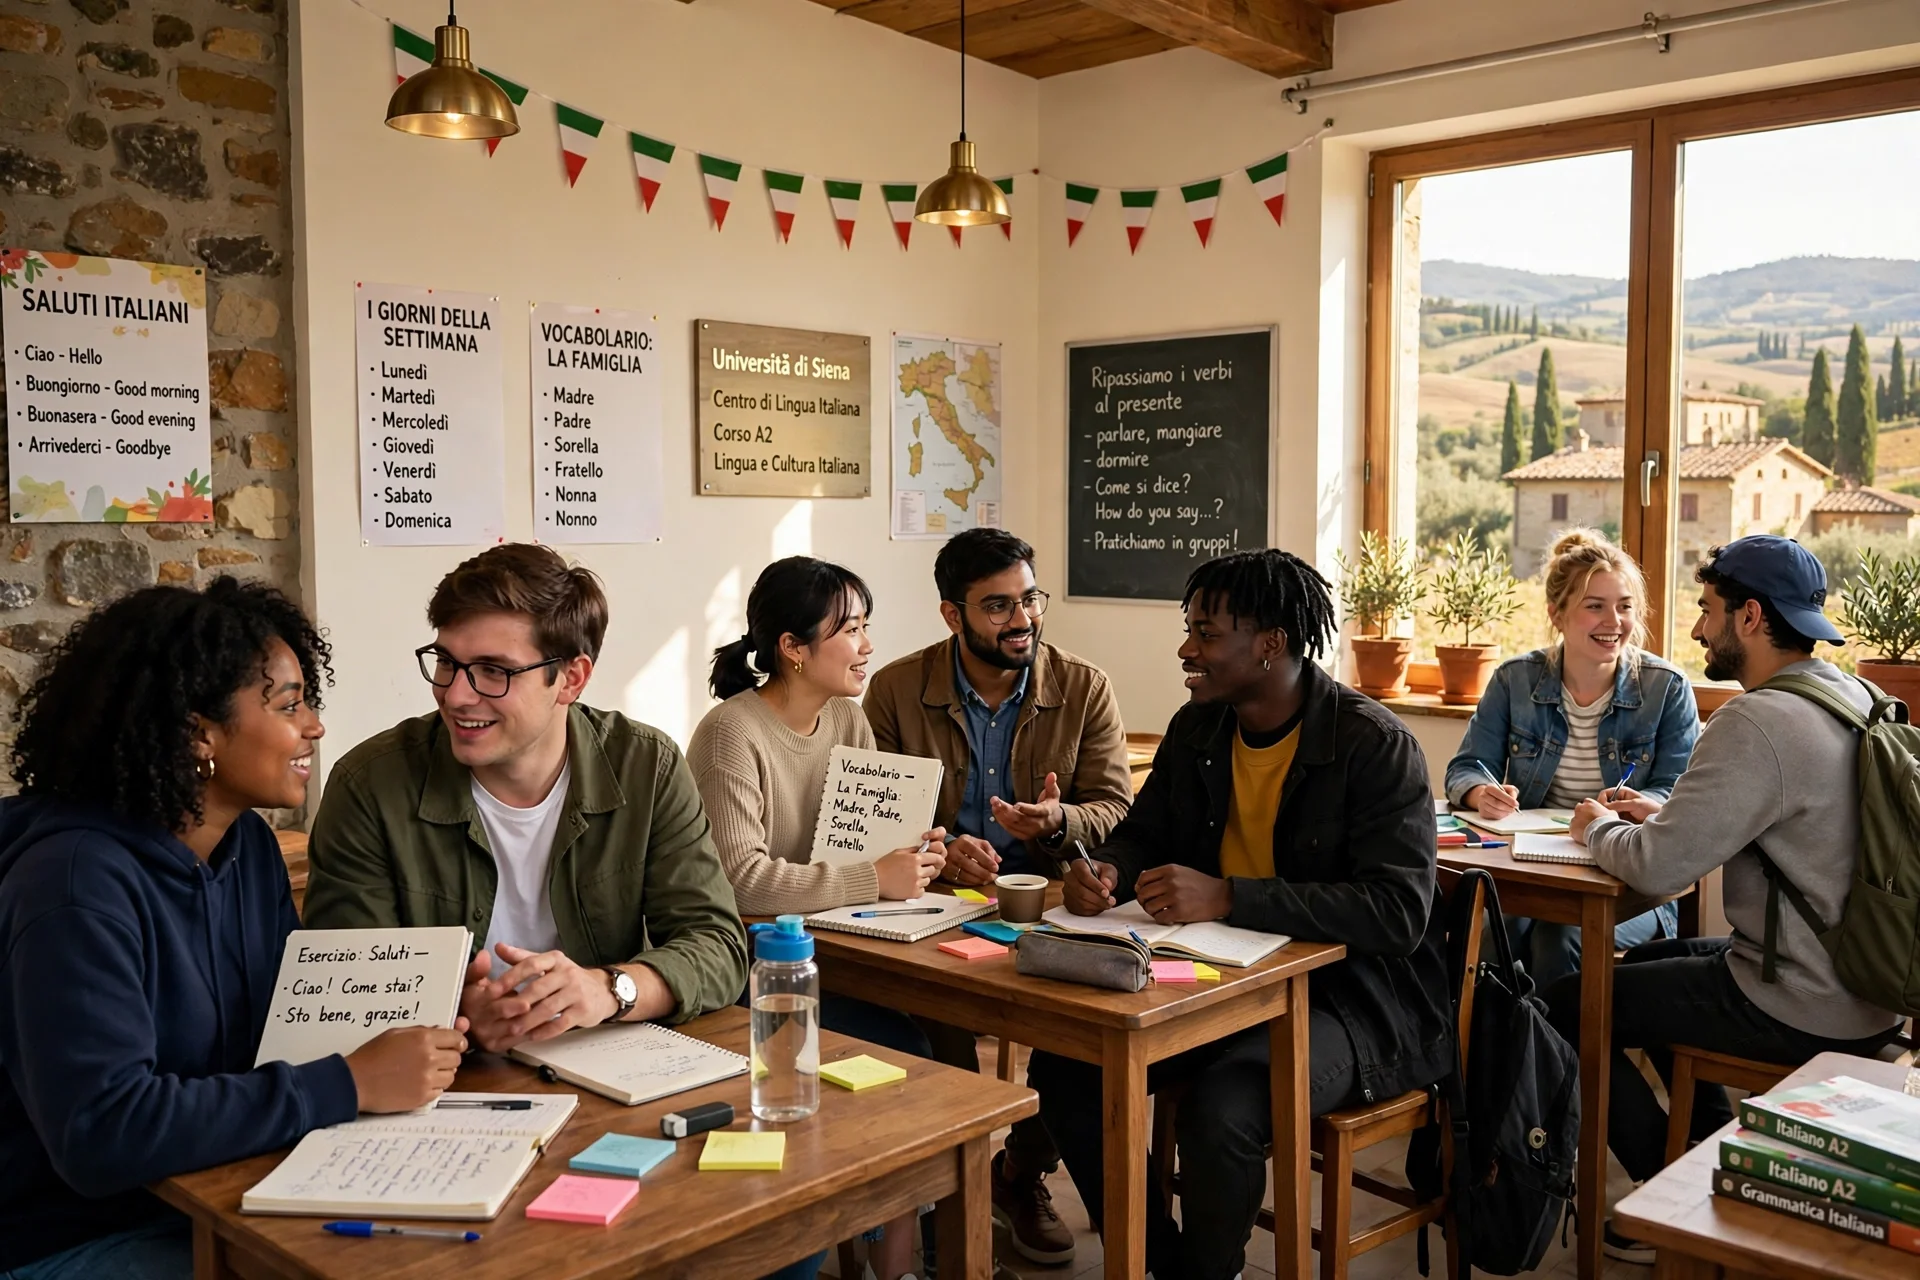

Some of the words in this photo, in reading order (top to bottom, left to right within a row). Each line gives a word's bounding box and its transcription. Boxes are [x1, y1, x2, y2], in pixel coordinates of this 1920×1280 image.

[23, 288, 97, 316] SALUTI
[105, 296, 188, 323] ITALIANI
[368, 300, 371, 319] I
[378, 301, 435, 324] GIORNI
[442, 307, 490, 330] DELLA
[384, 327, 478, 353] SETTIMANA
[541, 323, 652, 350] VOCABOLARIO:
[25, 345, 54, 362] Ciao
[70, 348, 102, 364] Hello
[548, 348, 567, 367] LA
[573, 351, 642, 373] FAMIGLIA
[382, 361, 427, 380] Lunedì
[795, 355, 808, 376] di
[812, 357, 850, 380] Siena
[1092, 366, 1173, 394] Ripassiamo
[1181, 365, 1186, 383] i
[1194, 360, 1231, 381] verbi
[27, 375, 100, 397] Buongiorno
[115, 380, 146, 396] Good
[151, 384, 199, 403] morning
[383, 386, 434, 405] Martedì
[554, 386, 594, 405] Madre
[714, 390, 756, 409] Centro
[760, 393, 771, 410] di
[776, 394, 815, 417] Lingua
[819, 397, 860, 416] Italiana
[1095, 395, 1108, 413] al
[1118, 391, 1182, 420] presente
[28, 405, 96, 423] Buonasera
[111, 409, 144, 425] Good
[148, 412, 195, 431] evening
[383, 412, 448, 430] Mercoledì
[555, 411, 591, 429] Padre
[714, 423, 751, 442] Corso
[755, 426, 772, 443] A2
[1097, 423, 1150, 449] parlare,
[1157, 423, 1222, 447] mangiare
[29, 436, 101, 454] Arrivederci
[116, 439, 170, 459] Goodbye
[384, 437, 433, 454] Giovedì
[555, 436, 598, 453] Sorella
[715, 452, 756, 475] Lingua
[761, 459, 768, 471] e
[772, 455, 815, 472] Cultura
[819, 457, 859, 474] Italiana
[1097, 450, 1149, 468] dormire
[383, 461, 435, 478] Venerdì
[556, 461, 603, 478] Fratello
[385, 487, 432, 503] Sabato
[556, 486, 596, 502] Nonna
[1096, 477, 1130, 495] Come
[1137, 479, 1146, 494] si
[386, 512, 451, 528] Domenica
[556, 510, 597, 526] Nonno
[1096, 502, 1122, 519] How
[1127, 502, 1142, 518] do
[1149, 508, 1170, 525] you
[1095, 531, 1165, 549] Pratichiamo
[1173, 535, 1183, 549] in
[842, 759, 900, 779] Vocabolario
[837, 780, 849, 793] La
[832, 799, 867, 818] Madre,
[873, 804, 902, 823] Padre,
[831, 816, 868, 835] Sorella,
[827, 834, 863, 851] Fratello
[298, 947, 361, 963] Esercizio:
[369, 944, 410, 961] Saluti
[342, 978, 377, 994] Come
[285, 1007, 310, 1023] Sto
[319, 1006, 355, 1023] bene,
[1777, 1119, 1825, 1148] Italiano
[1828, 1138, 1848, 1157] A2
[1769, 1161, 1828, 1191] Italiano
[1831, 1179, 1856, 1200] A2
[1741, 1183, 1824, 1220] Grammatica
[1829, 1208, 1884, 1238] Italiana
